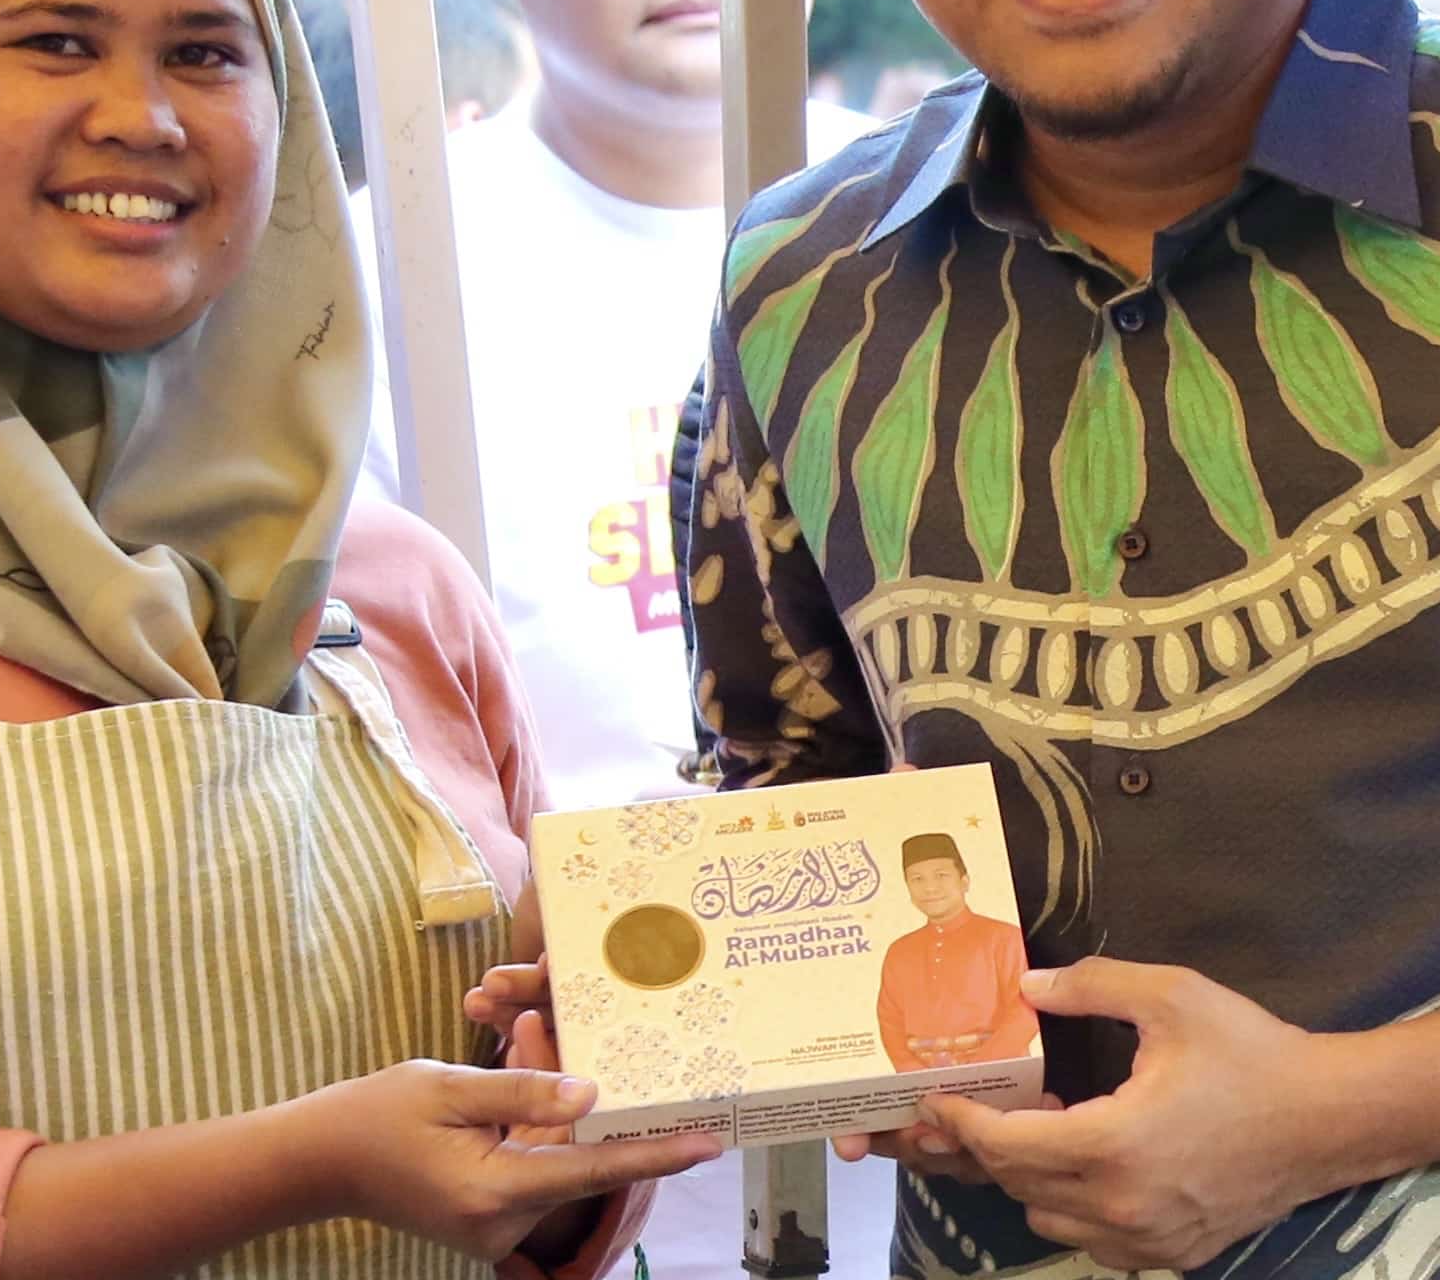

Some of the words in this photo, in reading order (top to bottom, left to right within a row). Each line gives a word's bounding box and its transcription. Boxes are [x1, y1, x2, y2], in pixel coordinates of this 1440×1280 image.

[726, 924, 864, 952] Ramadhan
[724, 937, 872, 969] Al-Mubarak
[602, 1131, 641, 1142] Abu
